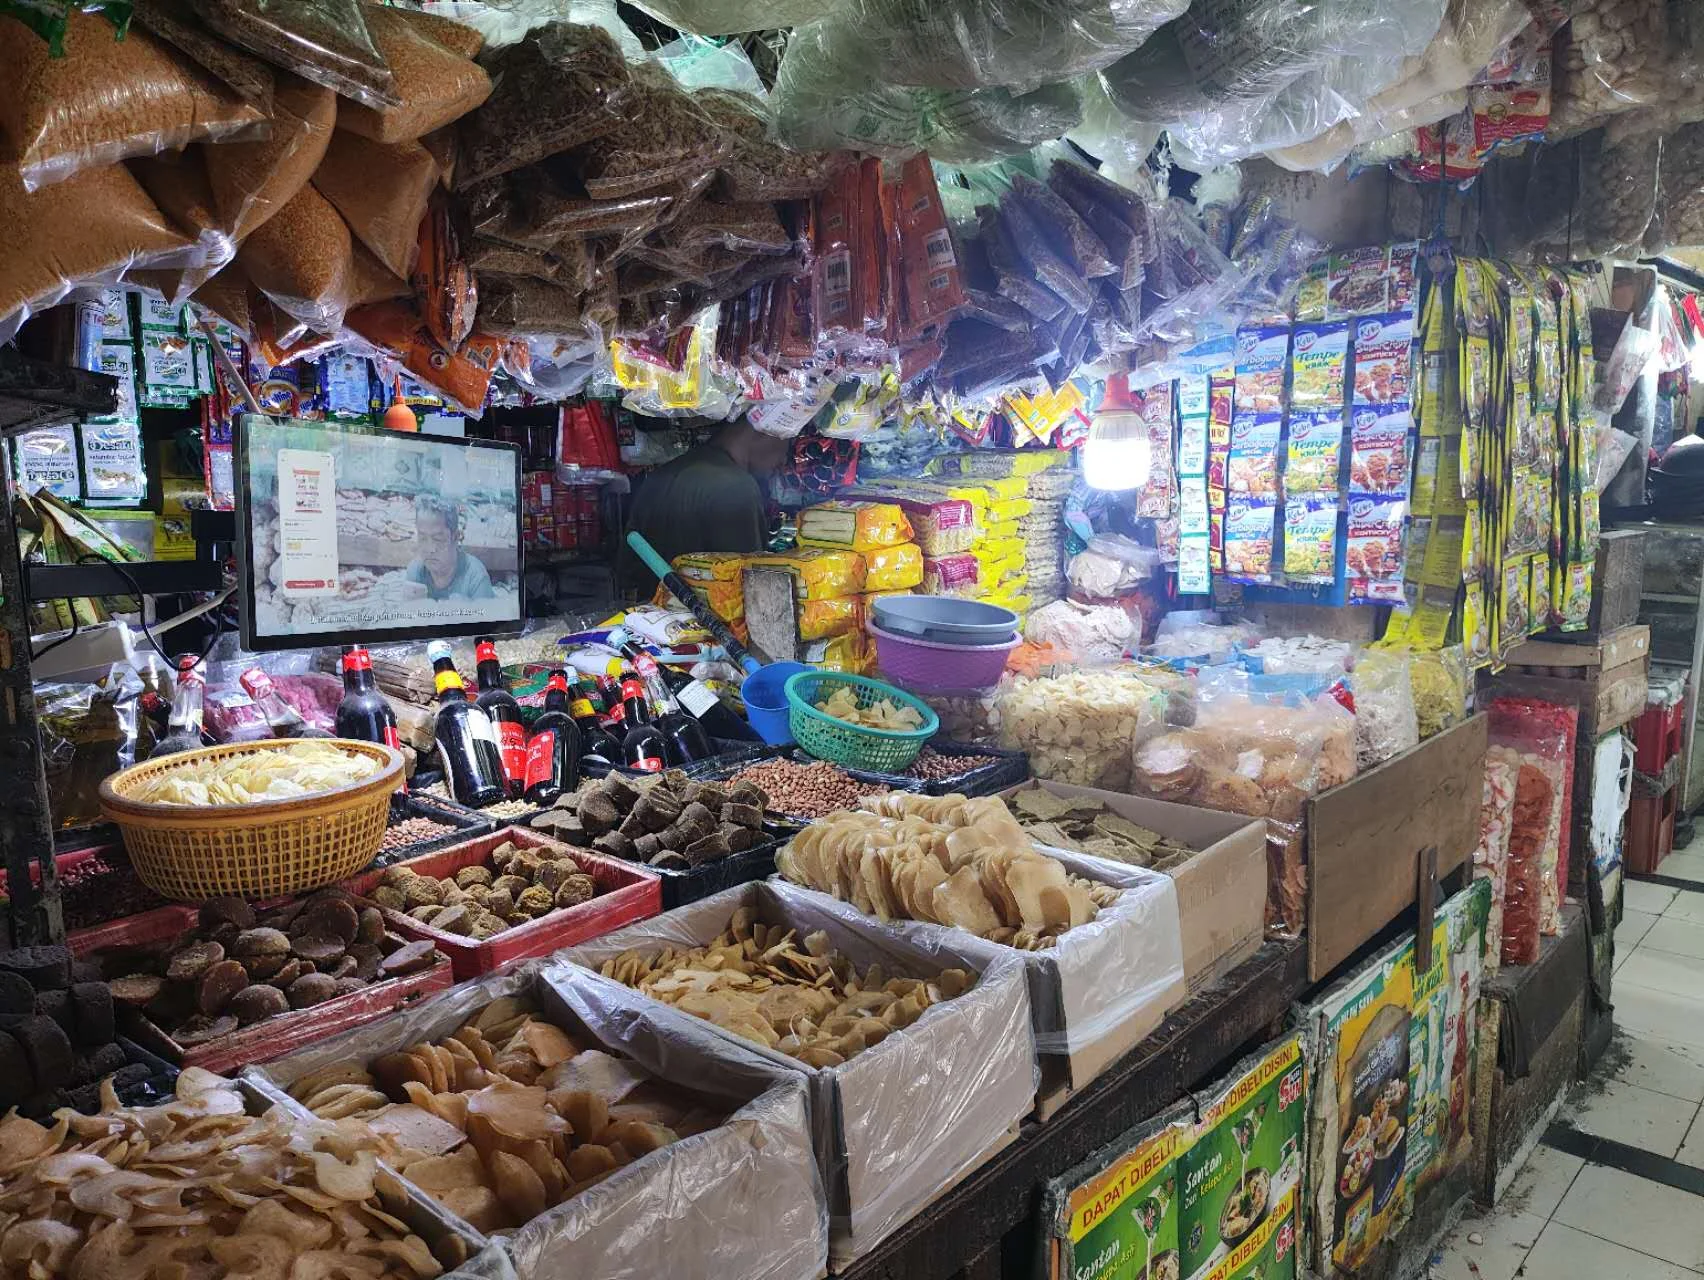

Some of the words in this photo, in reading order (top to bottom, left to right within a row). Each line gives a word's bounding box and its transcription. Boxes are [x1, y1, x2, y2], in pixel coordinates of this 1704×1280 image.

[1296, 352, 1340, 362] Tempe
[1291, 440, 1333, 450] Tempe
[1230, 1070, 1262, 1107] DIBELI
[1264, 1047, 1293, 1078] DISINI
[1083, 1177, 1126, 1228] DAPAT
[1130, 1141, 1171, 1187] DIBELI
[1185, 1152, 1222, 1194] Santan
[1231, 1229, 1267, 1268] DIBELI
